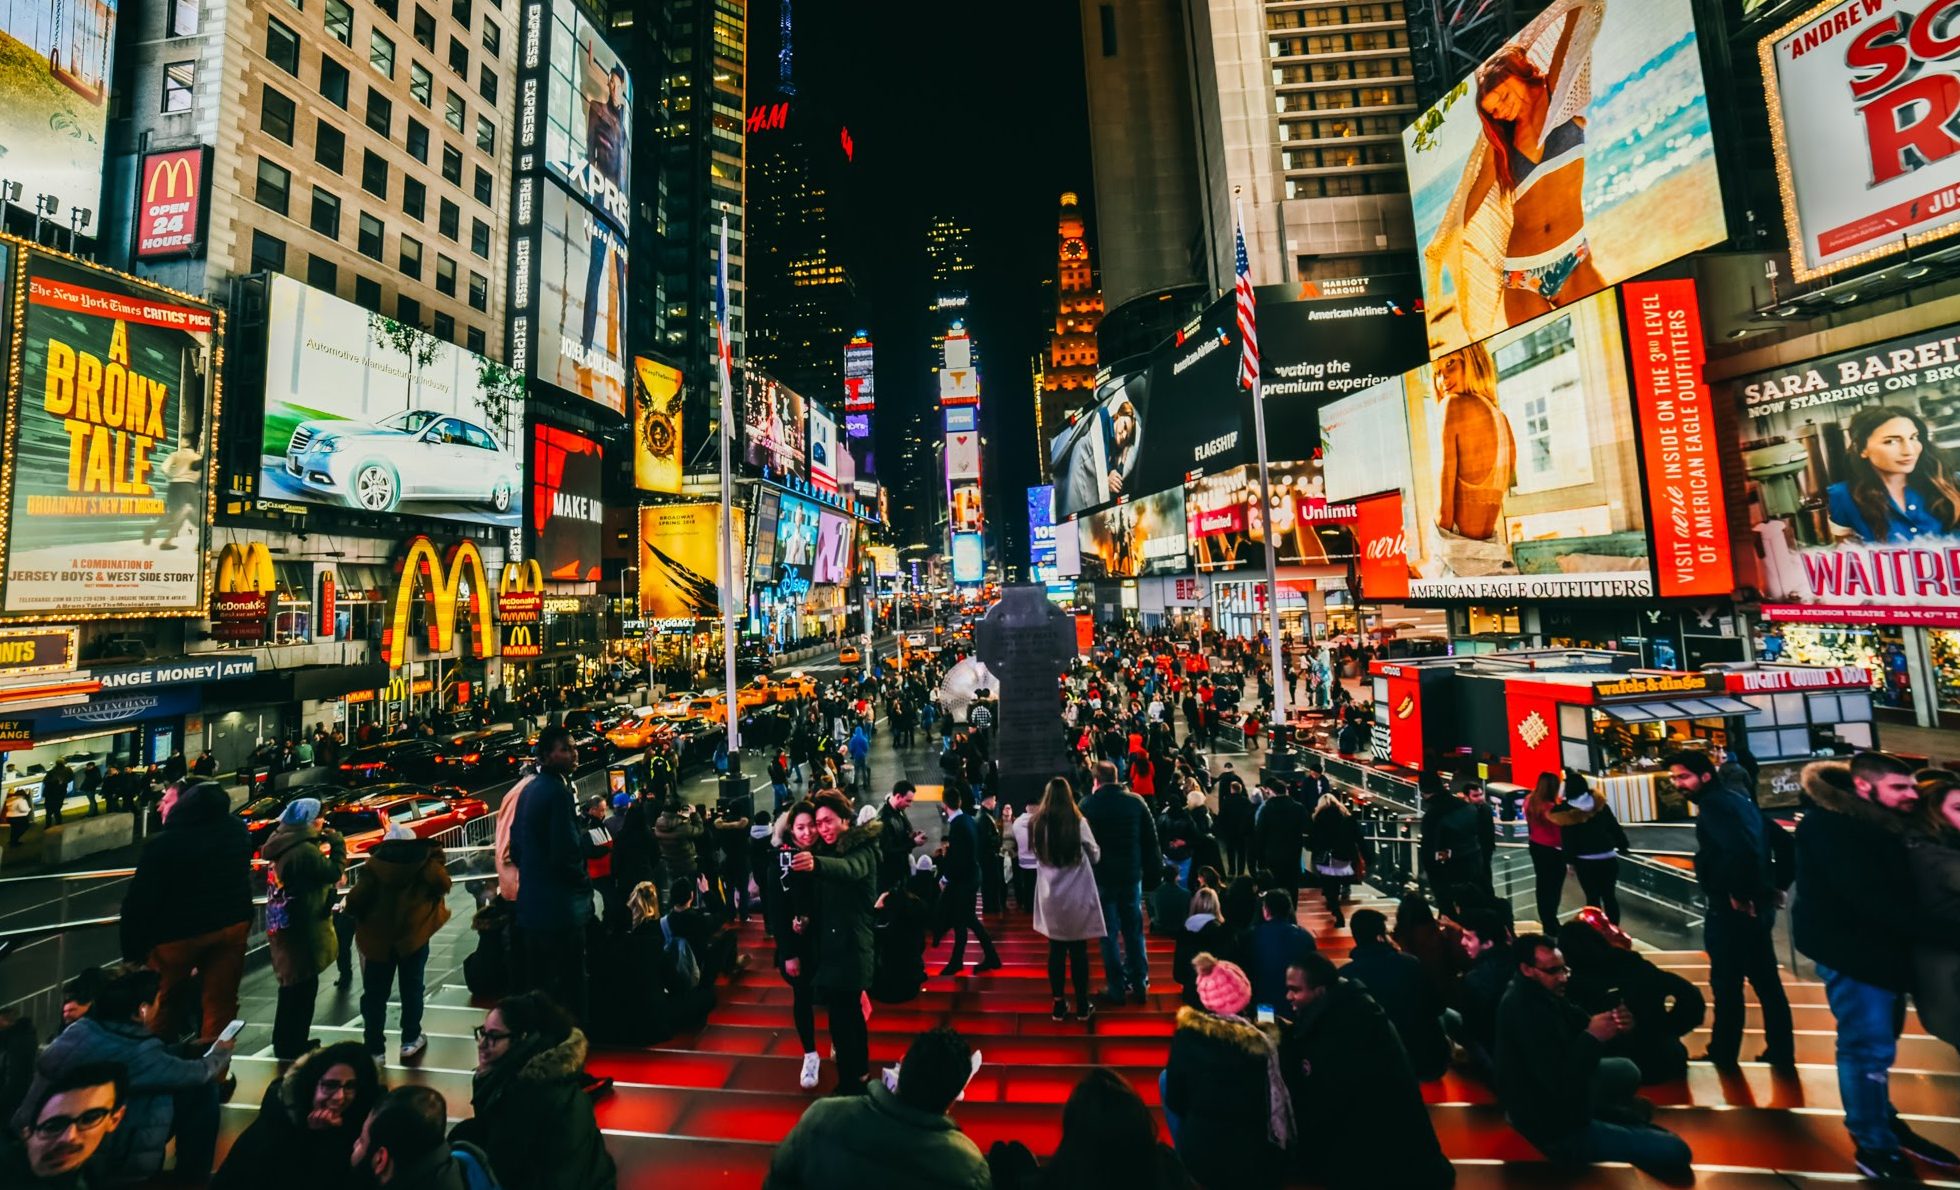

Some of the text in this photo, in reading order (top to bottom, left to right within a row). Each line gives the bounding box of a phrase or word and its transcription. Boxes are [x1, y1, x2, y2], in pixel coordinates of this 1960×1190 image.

[526, 4, 541, 68] EXPRESS
[522, 79, 537, 146] EXPRESS
[747, 102, 789, 133] H&M
[552, 148, 630, 238] XPRE
[149, 202, 190, 216] OPEN
[151, 216, 183, 235] 24
[142, 234, 193, 250] HOURS
[514, 236, 530, 309] EXPRESS
[1322, 278, 1369, 288] MARRIOTT
[29, 282, 212, 327] The New York Times CRITICS' PICK
[1323, 286, 1365, 296] MARQUIS
[1642, 293, 1664, 337] LEVEL
[108, 319, 129, 365] A
[306, 336, 360, 365] Automotive
[361, 356, 418, 385] Manufacturing
[1275, 360, 1351, 379] vating the
[1744, 335, 1960, 405] SARA BAREI
[44, 338, 168, 439] BRONX
[1261, 378, 1324, 399] premium
[1650, 367, 1671, 394] THE
[1748, 403, 1786, 419] NOW
[1790, 382, 1880, 410] STARRING
[1885, 373, 1917, 391] ON
[1656, 400, 1675, 422] ON
[1194, 431, 1238, 462] FLAGSHIP
[1668, 308, 1717, 564] OF AMERICAN EAGLE OUTFITTERS
[64, 418, 154, 495] TALE
[1660, 426, 1683, 480] INSIDE
[27, 495, 97, 515] BROADWAY'S
[99, 496, 120, 515] NEW
[120, 497, 135, 515] HIT
[553, 492, 588, 519] MAKE
[1663, 486, 1690, 538] aerie
[1201, 512, 1232, 532] Unlimited
[81, 559, 142, 569] COMBINATION
[144, 561, 154, 570] OF
[1675, 541, 1695, 584] VISIT
[9, 571, 58, 582] JERSEY
[61, 571, 93, 581] BOYS
[96, 571, 104, 581] &
[107, 572, 137, 582] WEST
[139, 573, 162, 582] SIDE
[1410, 578, 1650, 599] AMERICAN EAGLE OUTFITTERS
[500, 597, 540, 605] McDonald's
[543, 599, 580, 612] EXPRESS
[1802, 609, 1844, 617] ATKINSON
[0, 640, 36, 663] NTS
[94, 662, 254, 688] ANGE MONEY ATM
[63, 697, 158, 716] MONEY EXCHANGE
